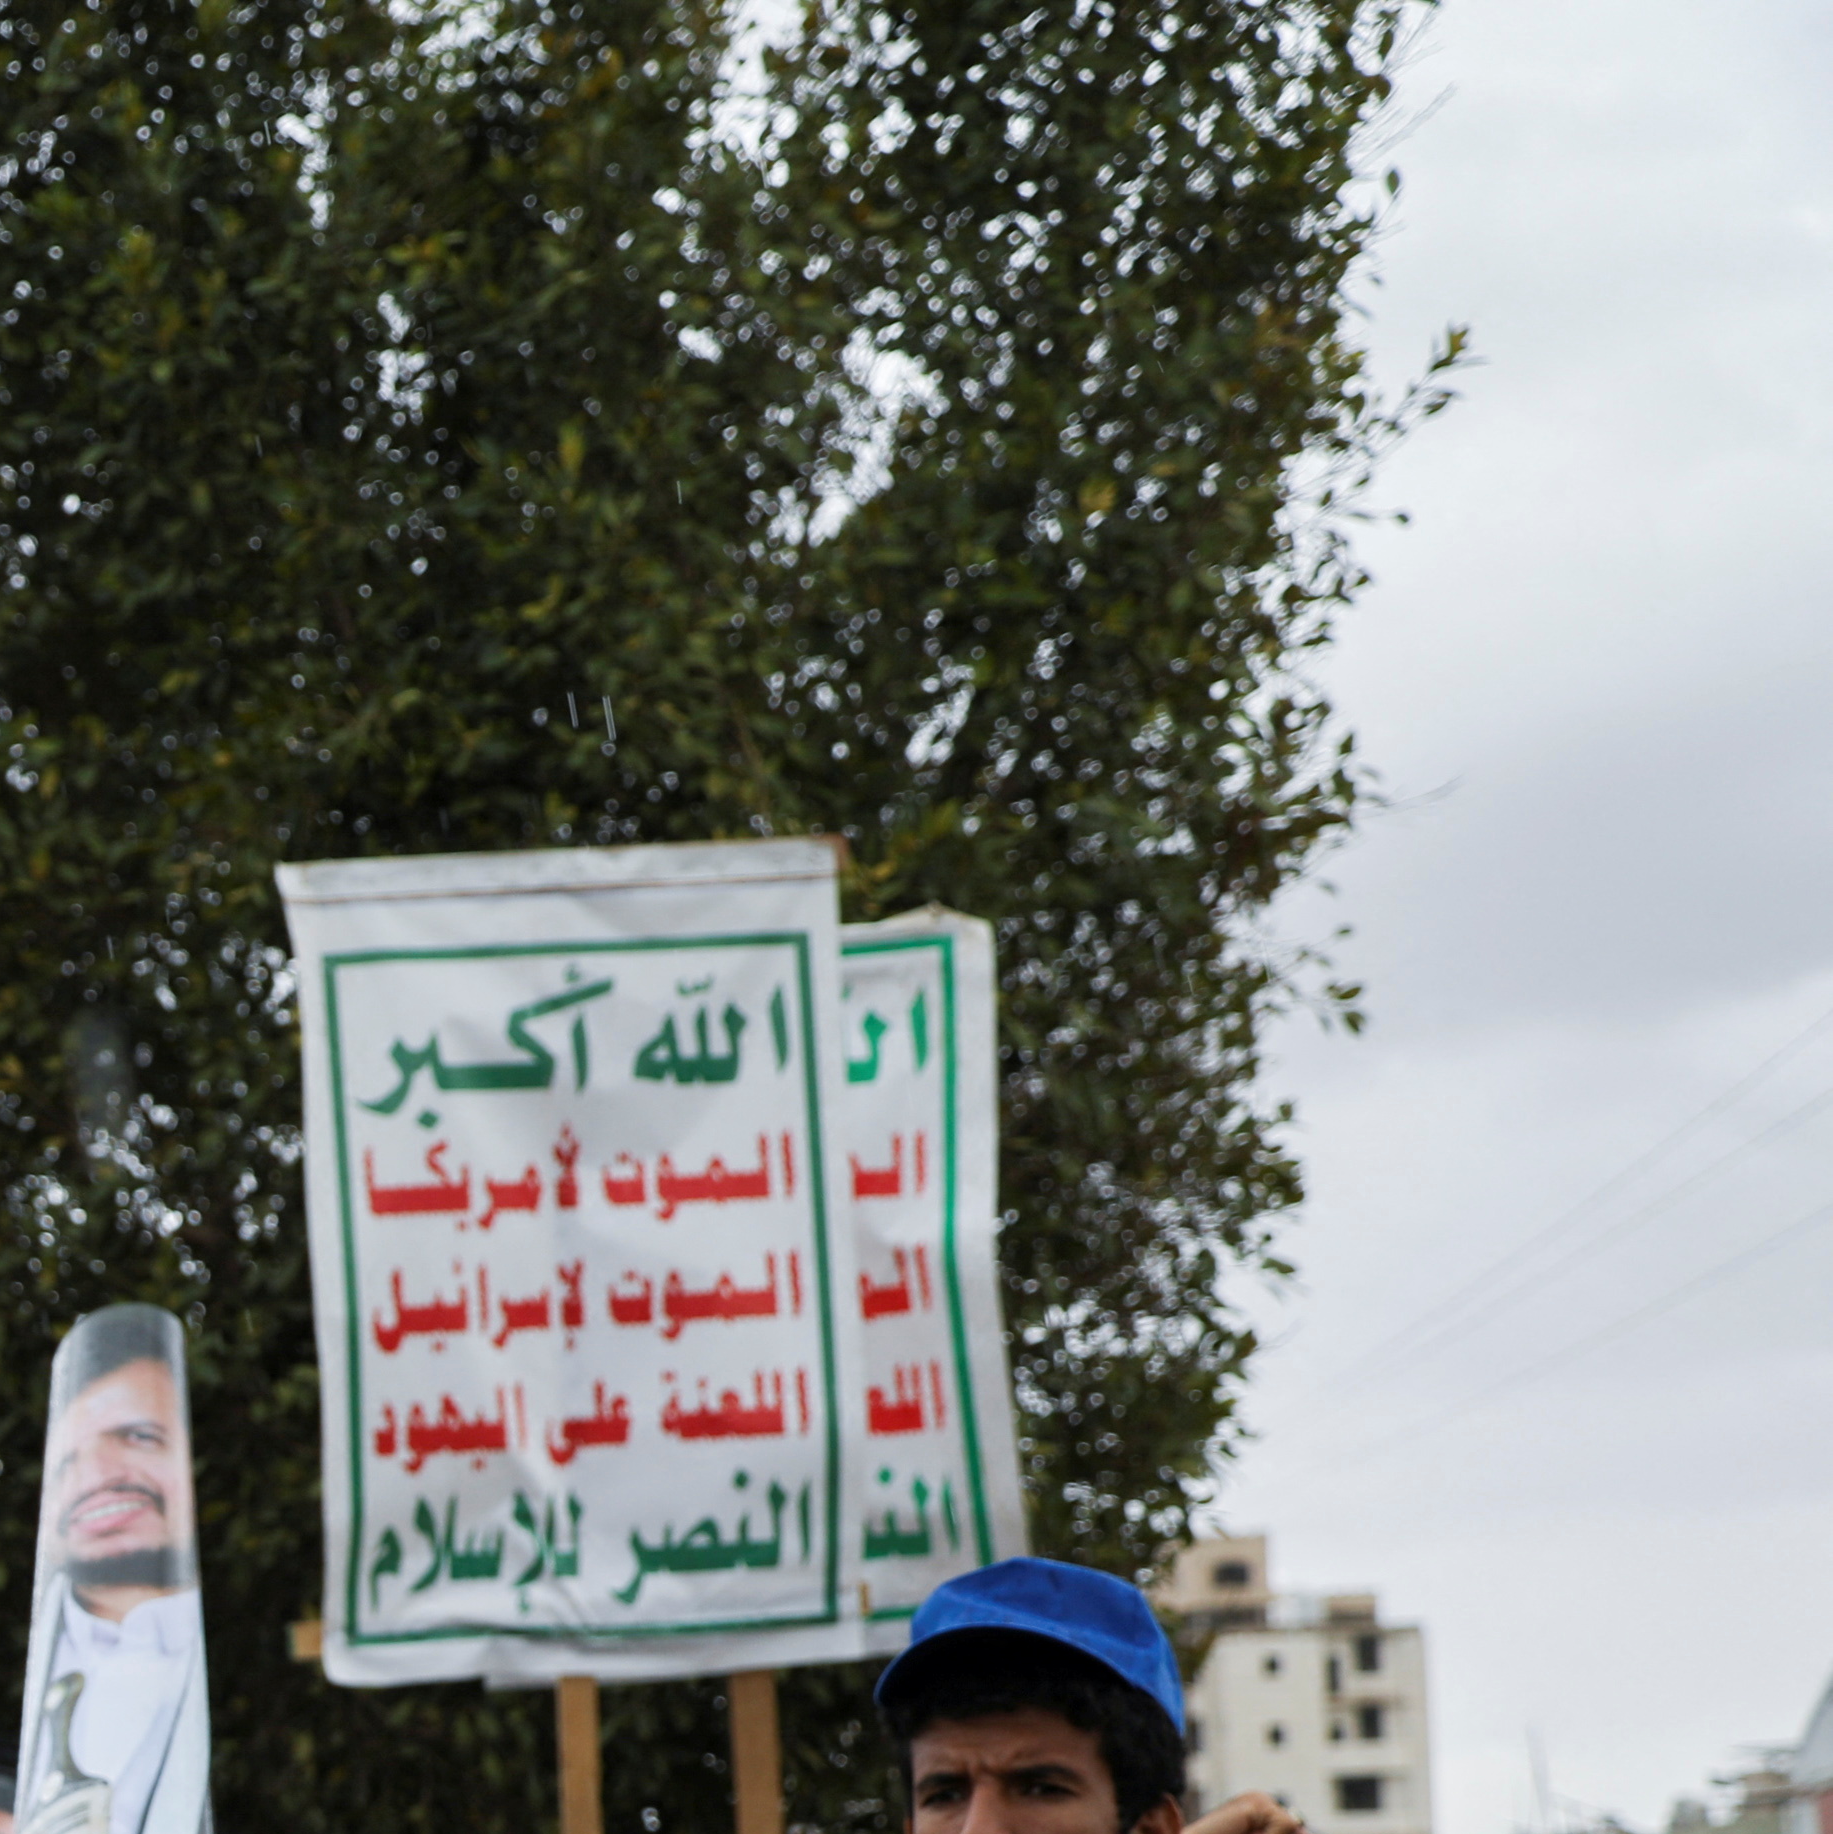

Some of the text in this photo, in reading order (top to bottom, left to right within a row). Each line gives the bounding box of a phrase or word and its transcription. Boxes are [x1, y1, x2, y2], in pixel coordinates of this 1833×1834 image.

[356, 963, 615, 1130] أكبر
[601, 1129, 796, 1222] الموت
[606, 1250, 802, 1342] الموت
[373, 1367, 810, 1475] اللعنة على اليهود
[611, 1468, 812, 1607] النصر
